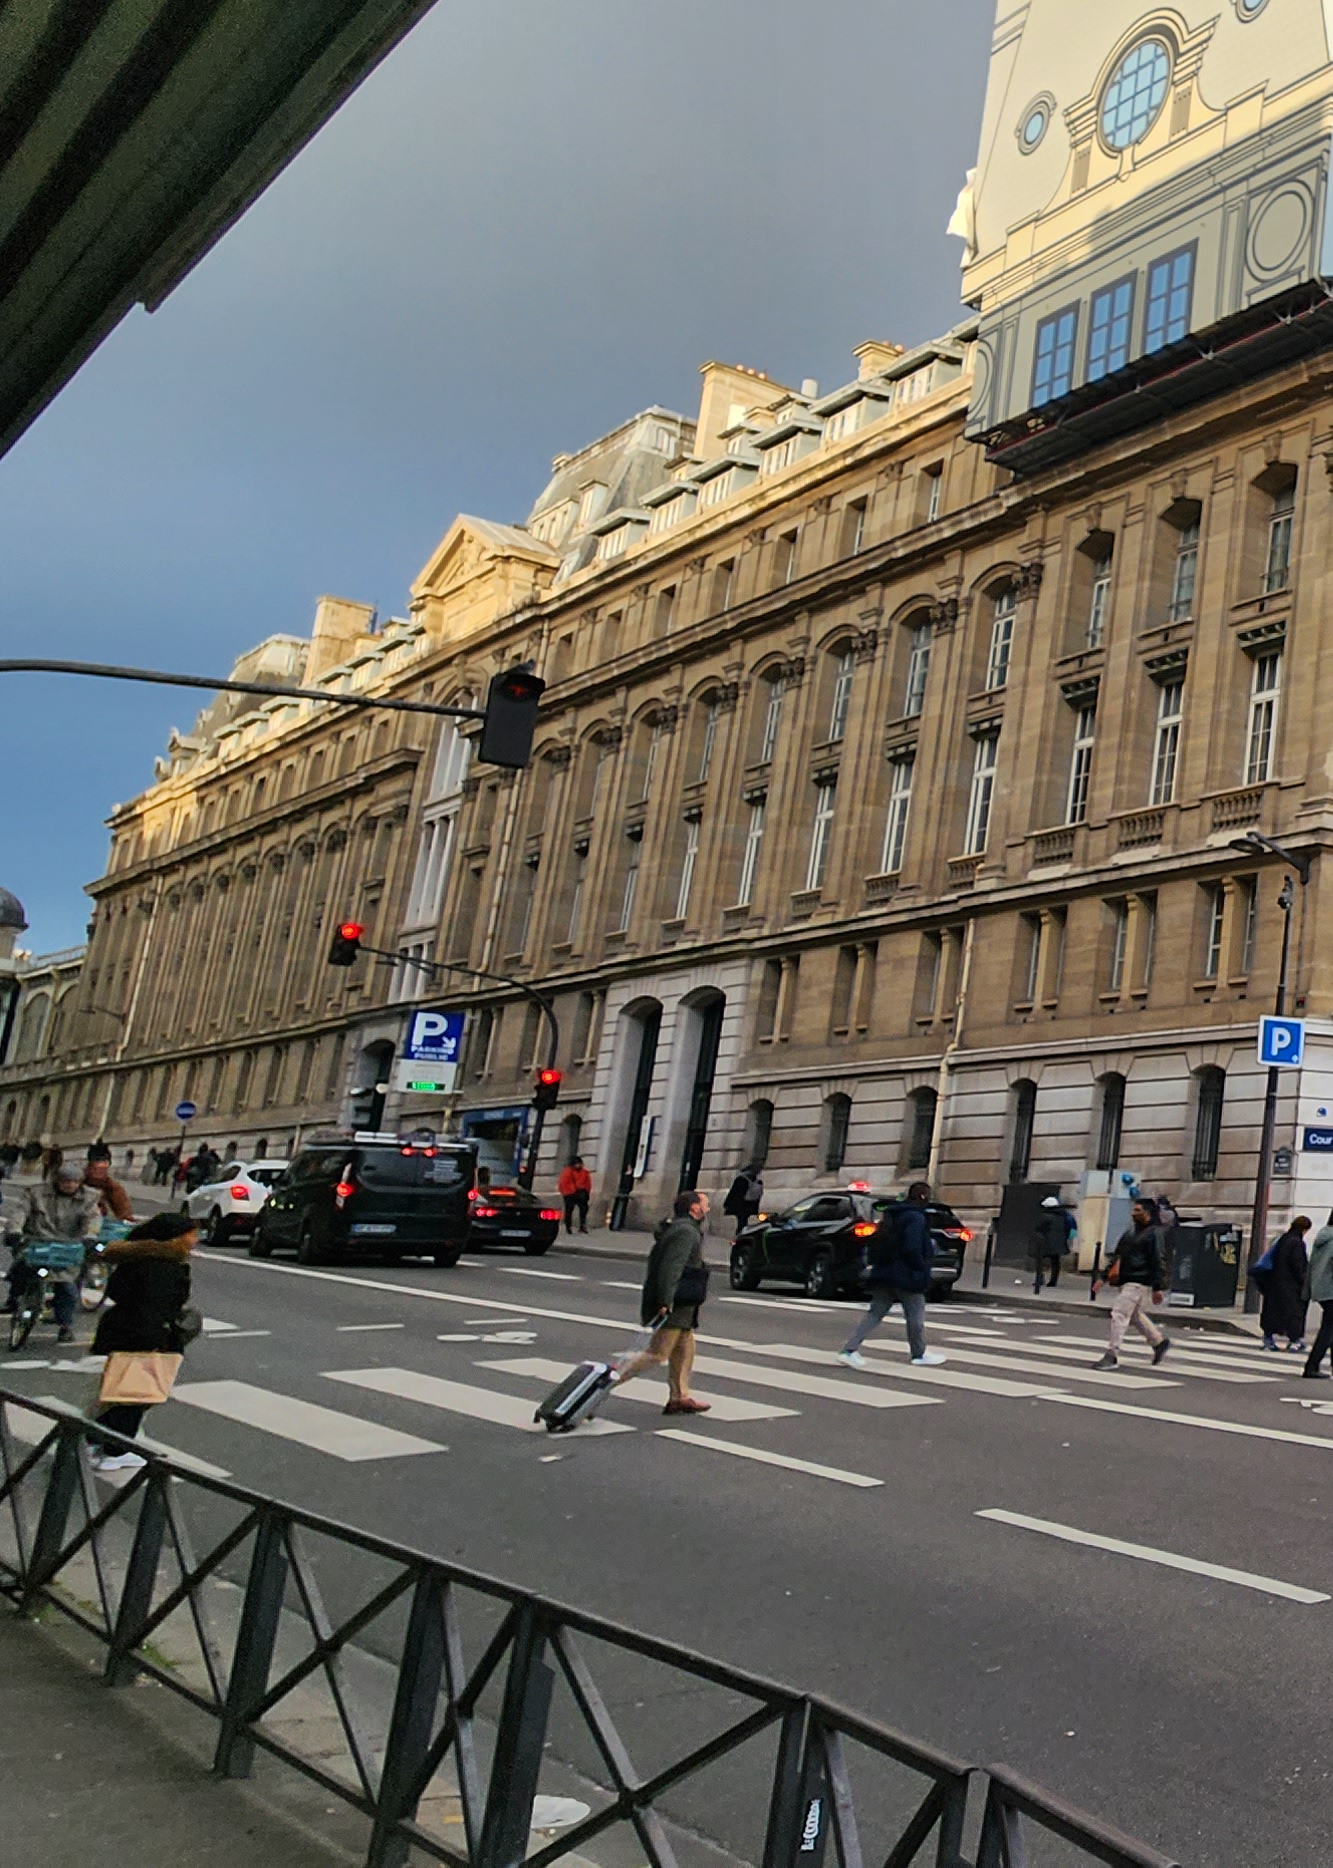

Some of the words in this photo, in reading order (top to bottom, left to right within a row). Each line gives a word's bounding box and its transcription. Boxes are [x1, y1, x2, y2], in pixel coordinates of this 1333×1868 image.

[412, 1012, 448, 1046] P
[1271, 1027, 1291, 1056] P
[1309, 1134, 1332, 1145] Cour
